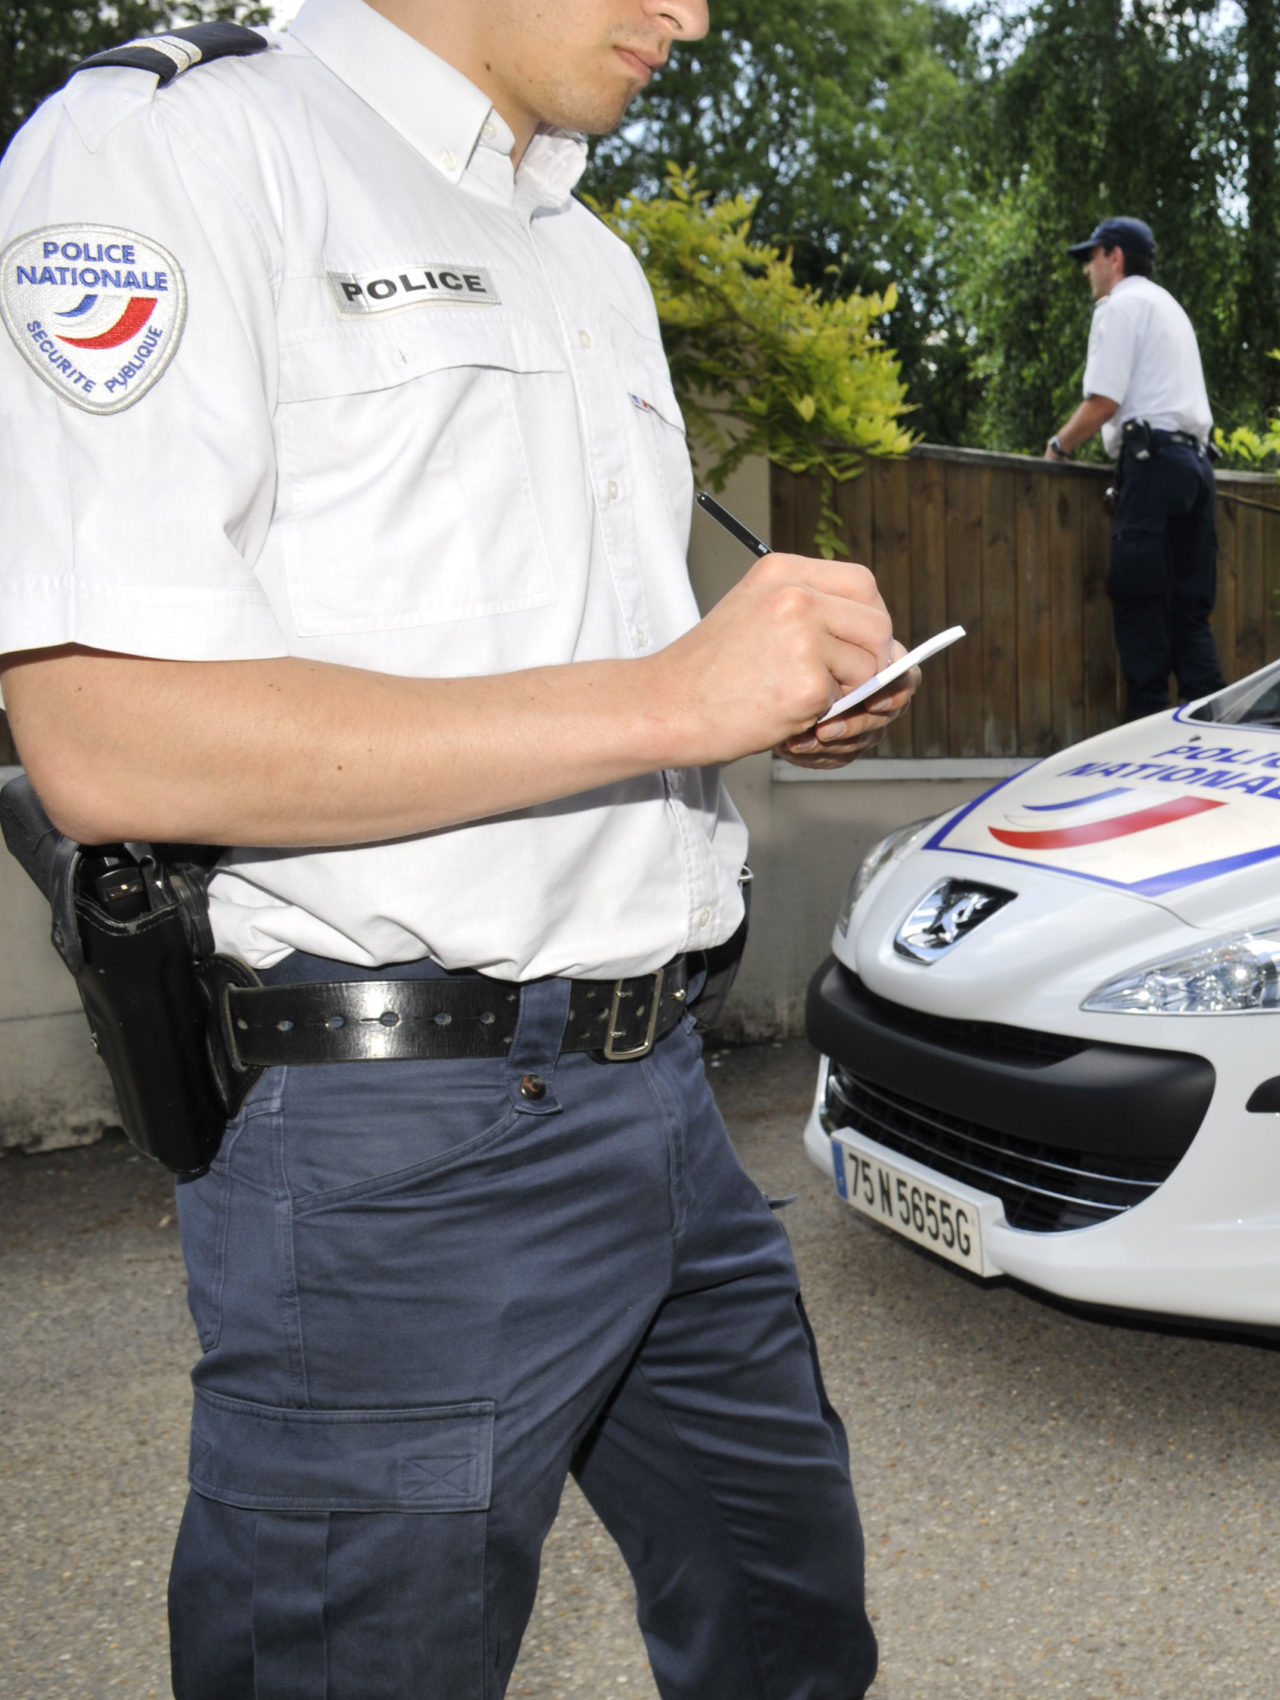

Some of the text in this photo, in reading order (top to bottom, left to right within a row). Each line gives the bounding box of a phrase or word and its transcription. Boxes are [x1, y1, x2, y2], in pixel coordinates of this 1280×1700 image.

[43, 241, 136, 265] POLICE
[16, 266, 168, 291] NATIONALE
[340, 271, 487, 302] POLICE
[26, 320, 164, 394] SECURITE PUBLIQUE
